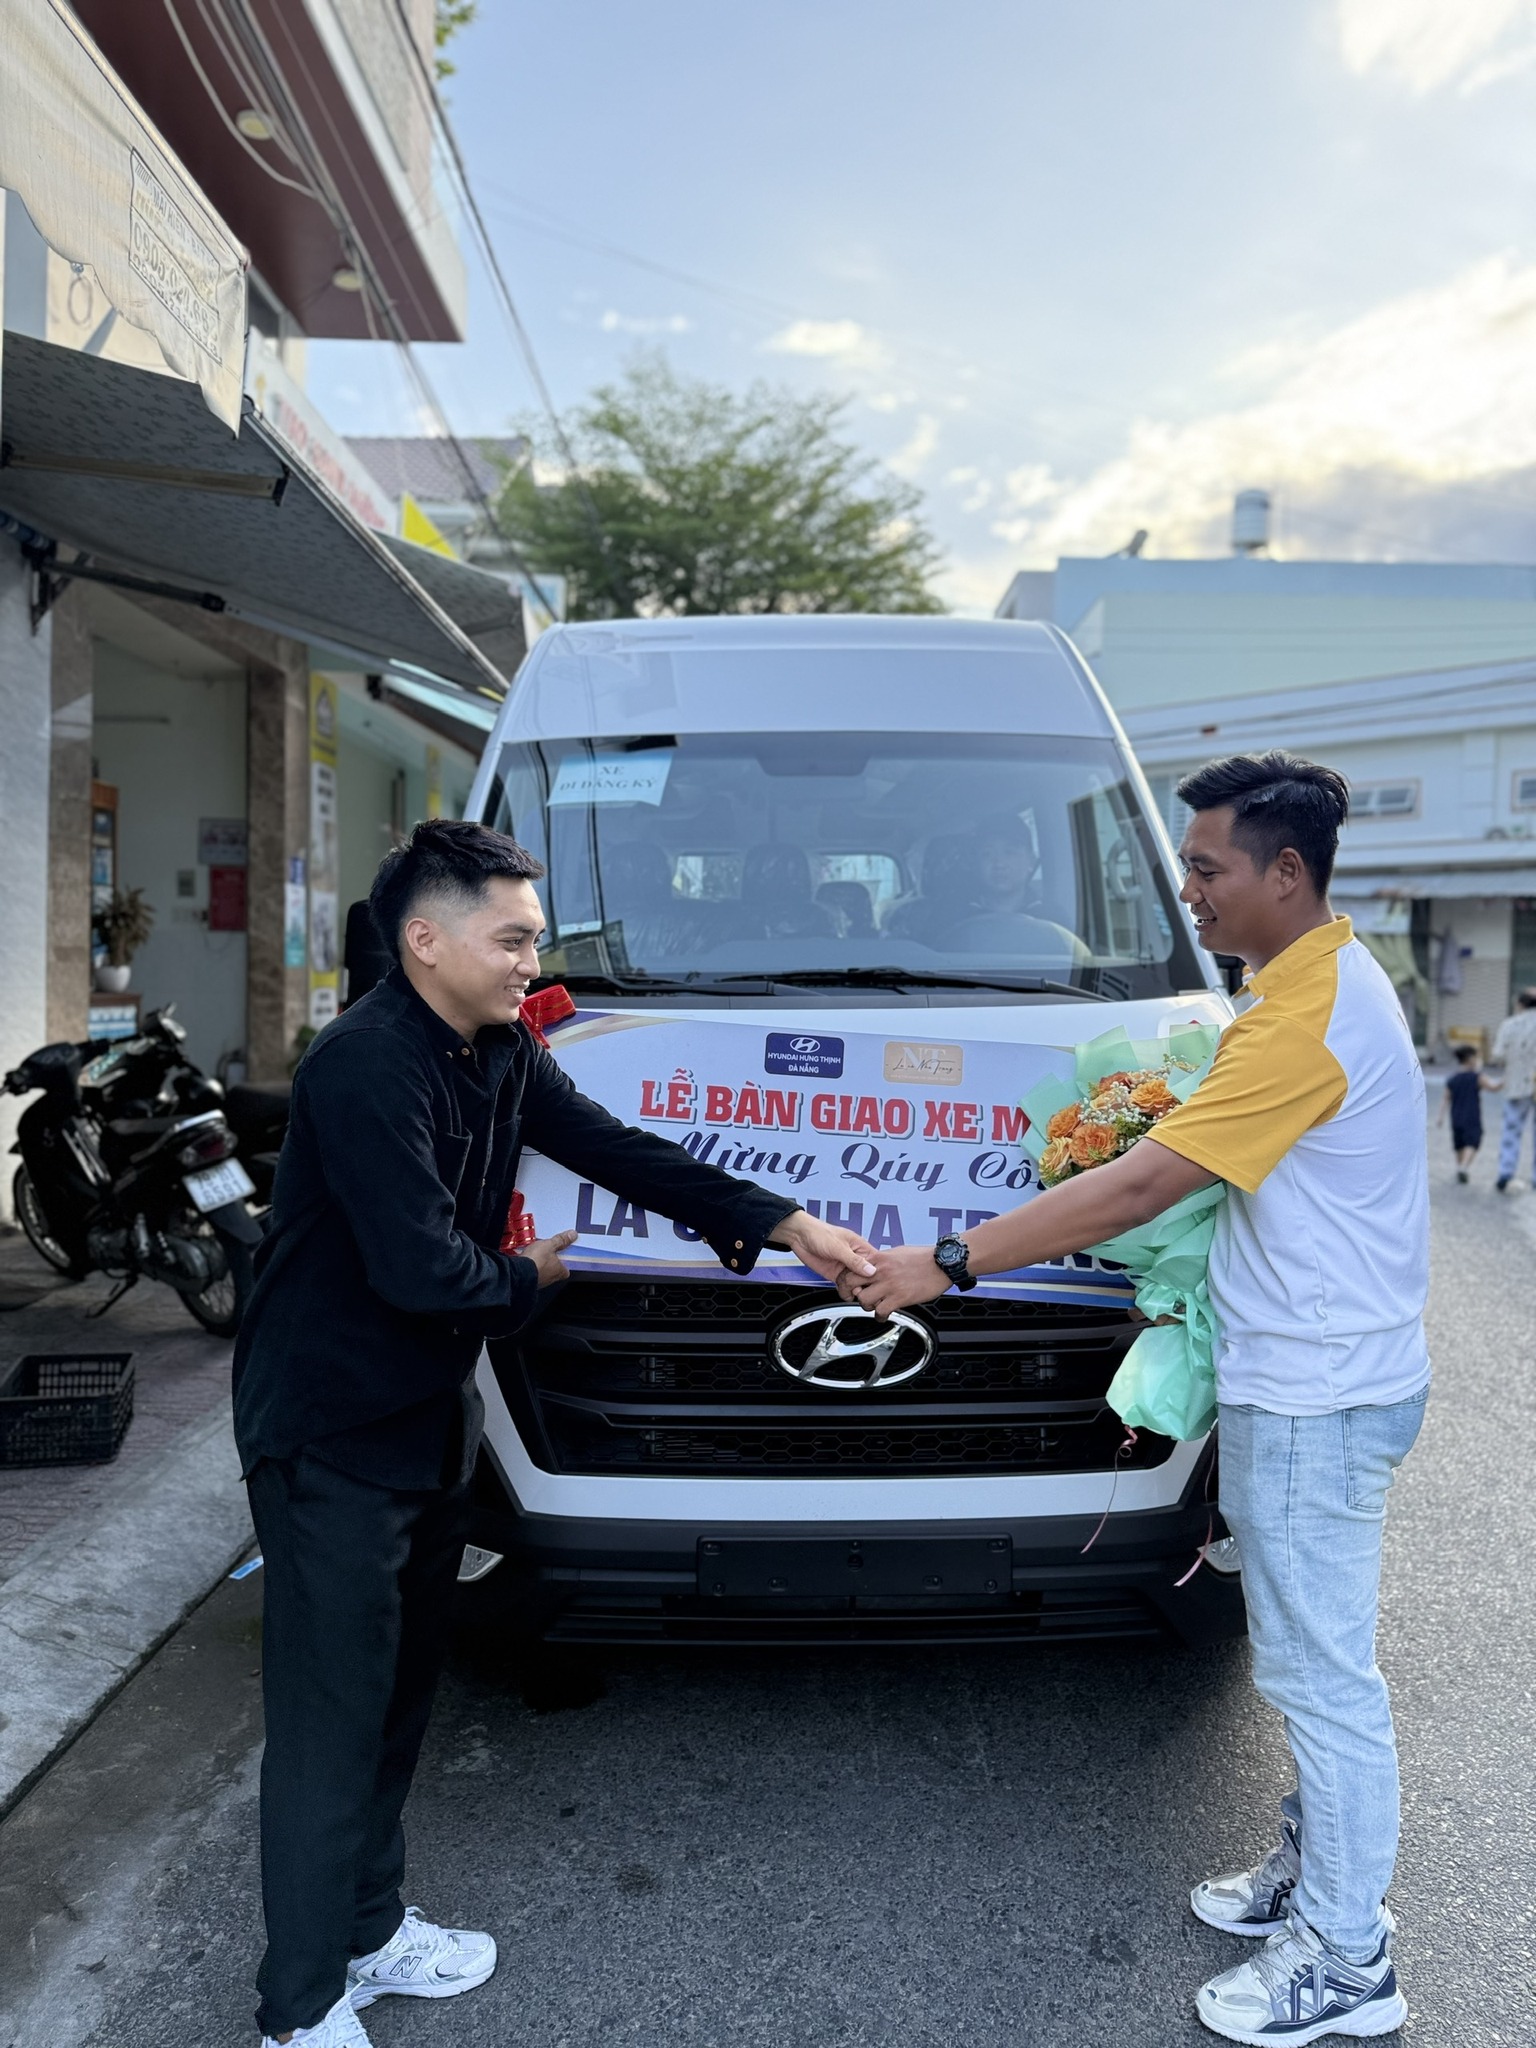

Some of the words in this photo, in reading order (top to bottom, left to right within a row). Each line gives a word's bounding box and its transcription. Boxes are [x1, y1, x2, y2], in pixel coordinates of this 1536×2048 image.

[600, 766, 625, 775] XE
[767, 1052, 798, 1061] HYUNDAI
[819, 1056, 841, 1065] THỊNH
[788, 1063, 798, 1072] ĐÀ
[799, 1062, 819, 1074] NẴNG
[640, 1068, 697, 1123] LỄ
[705, 1081, 802, 1132] BÀN
[811, 1093, 915, 1140] GIAO
[923, 1101, 983, 1144] XE
[968, 1151, 1046, 1191] Cô
[786, 1198, 905, 1251] HA
[389, 1955, 422, 1979] N
